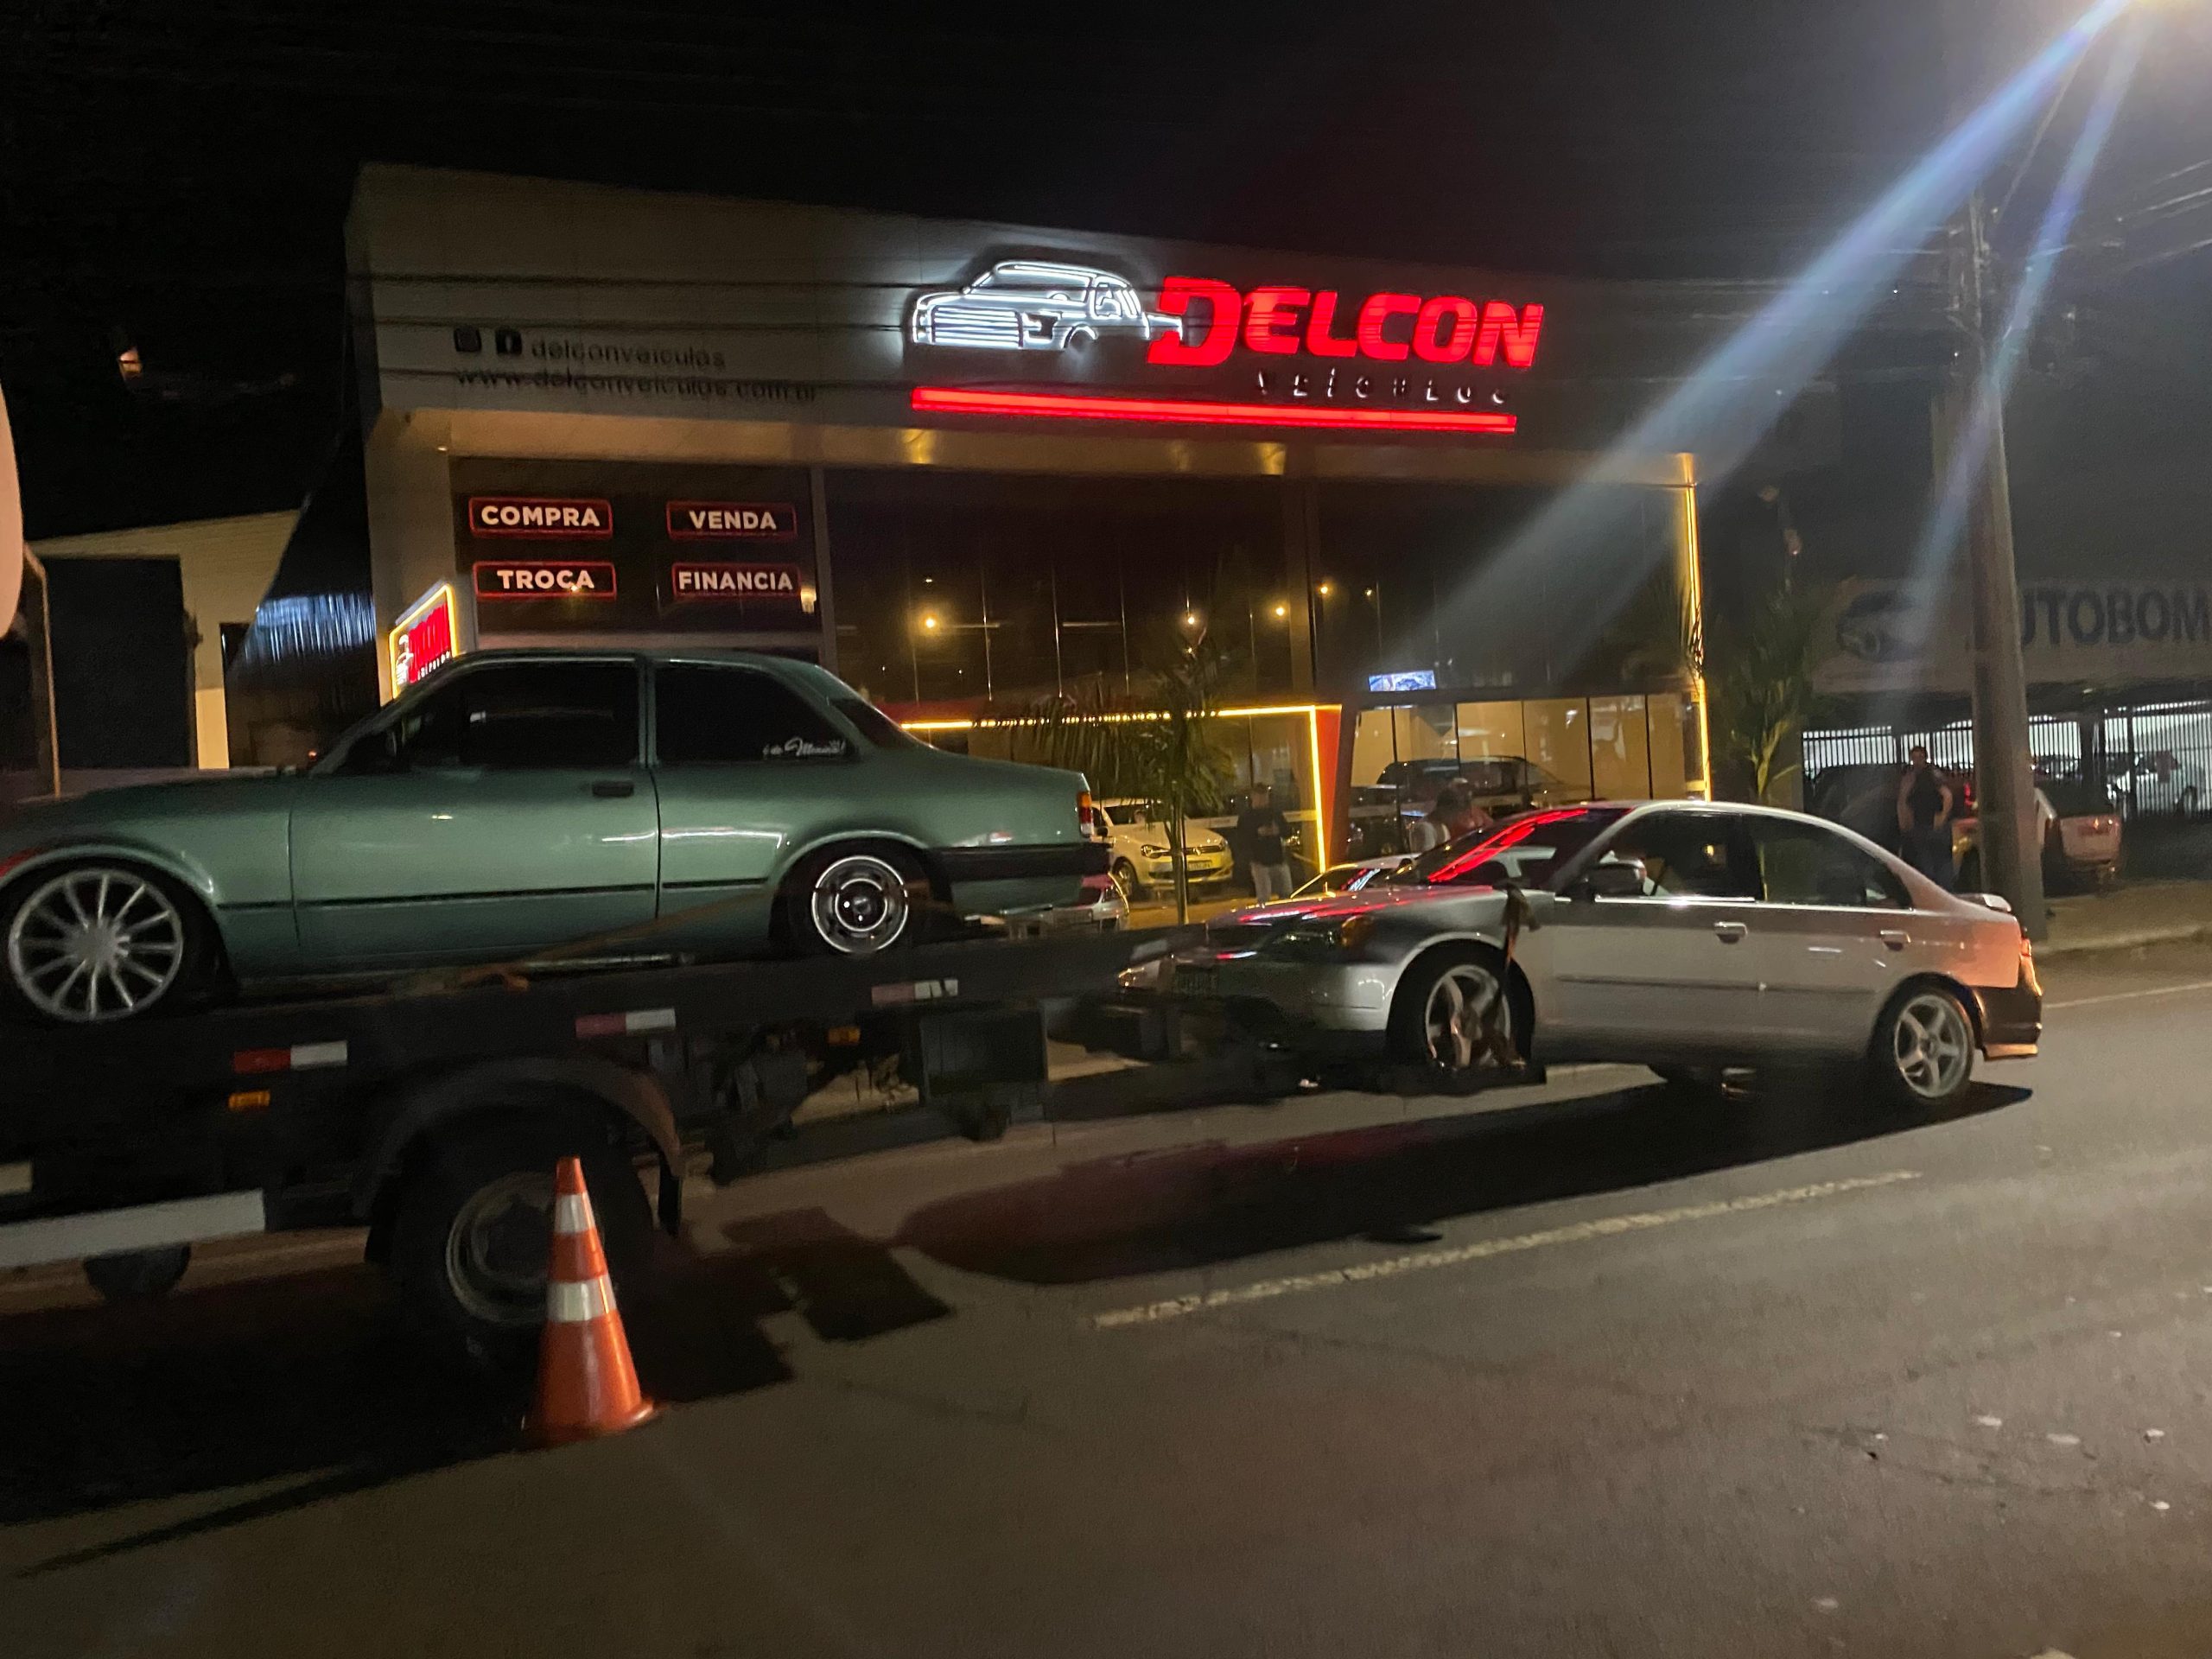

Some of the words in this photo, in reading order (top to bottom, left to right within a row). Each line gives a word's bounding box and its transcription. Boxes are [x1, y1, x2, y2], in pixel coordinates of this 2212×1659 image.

[1147, 276, 1544, 368] DELCON
[481, 505, 601, 527] COMPRA
[689, 510, 778, 531] VENDA
[497, 569, 595, 590] TROCA
[677, 570, 794, 592] FINANCIA
